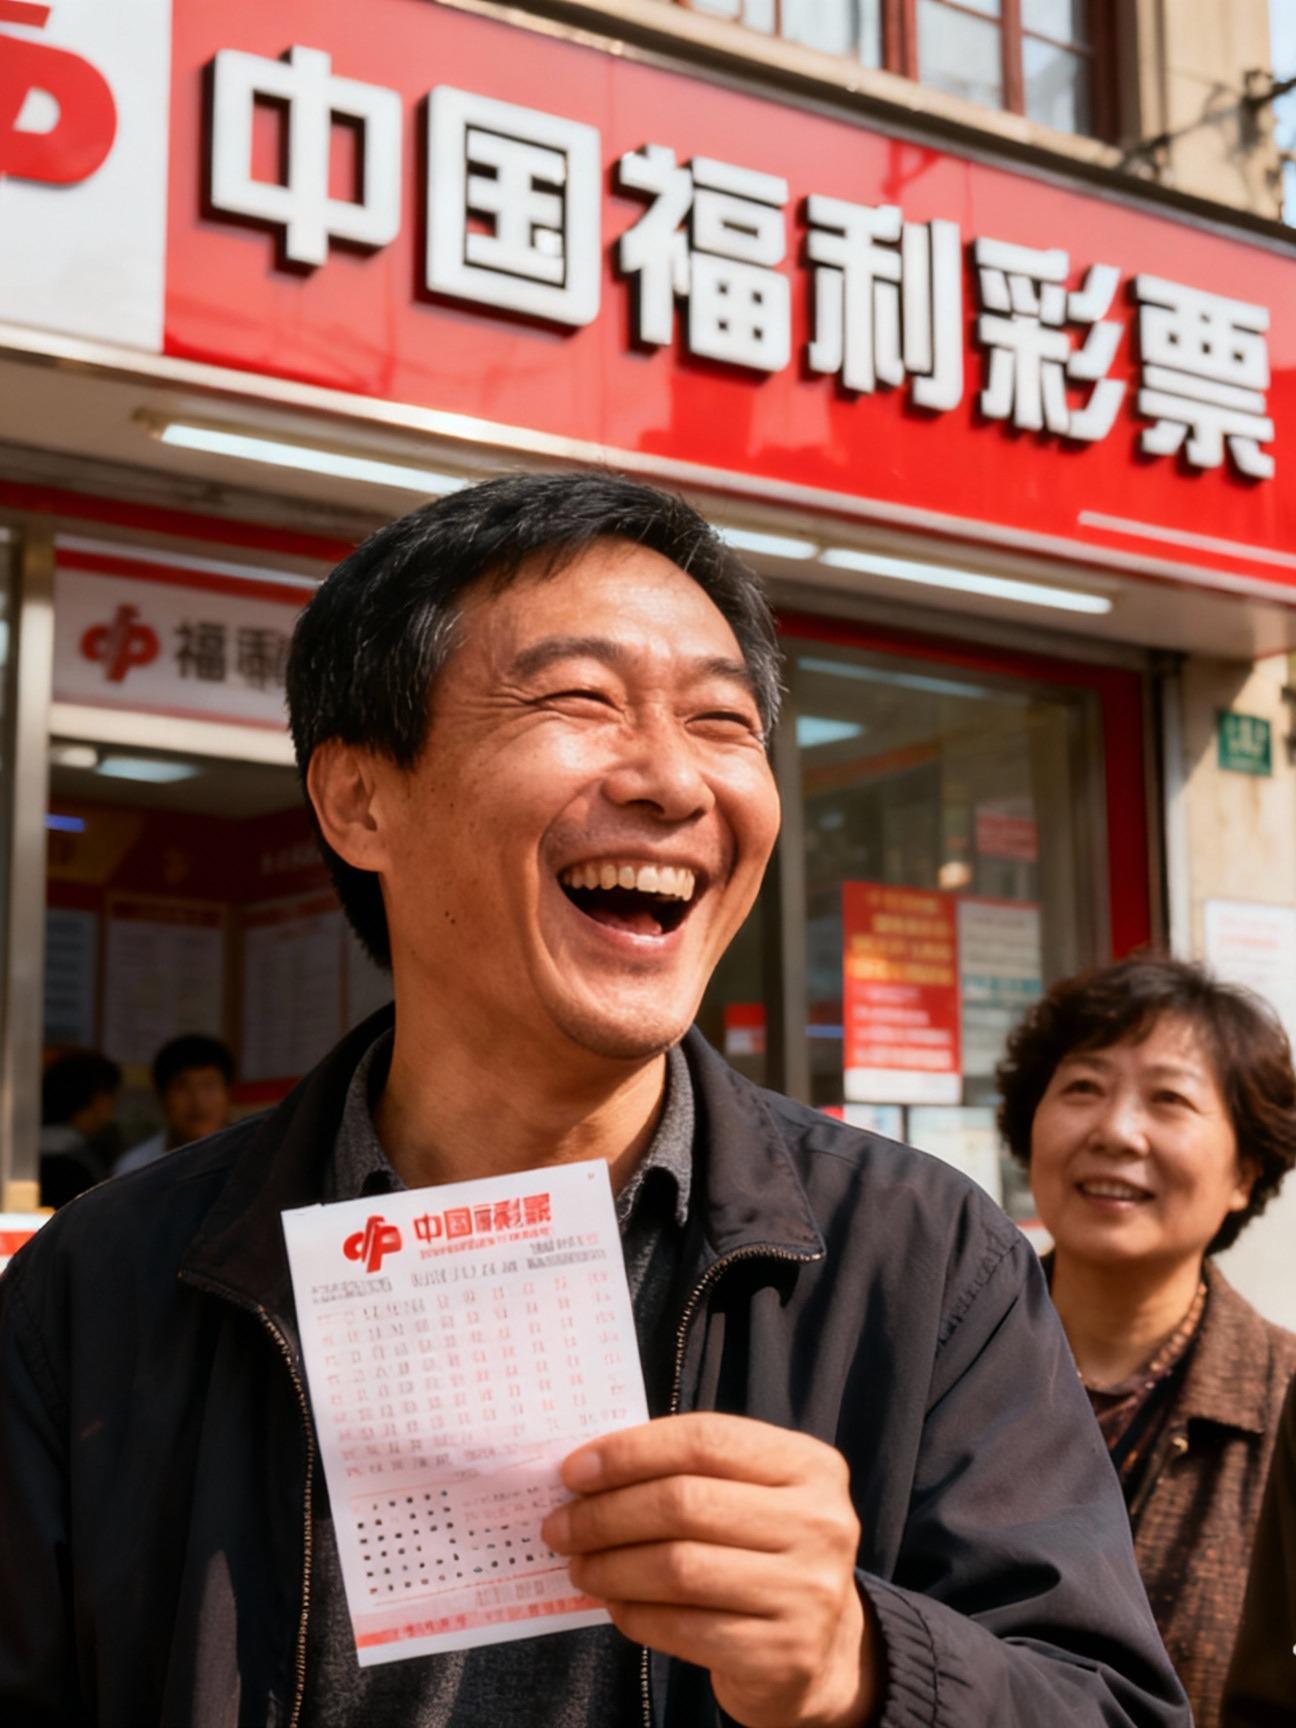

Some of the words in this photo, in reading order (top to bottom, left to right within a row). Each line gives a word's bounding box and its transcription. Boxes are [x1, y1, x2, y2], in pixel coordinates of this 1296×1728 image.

[207, 44, 1276, 481] 中国福利彩票
